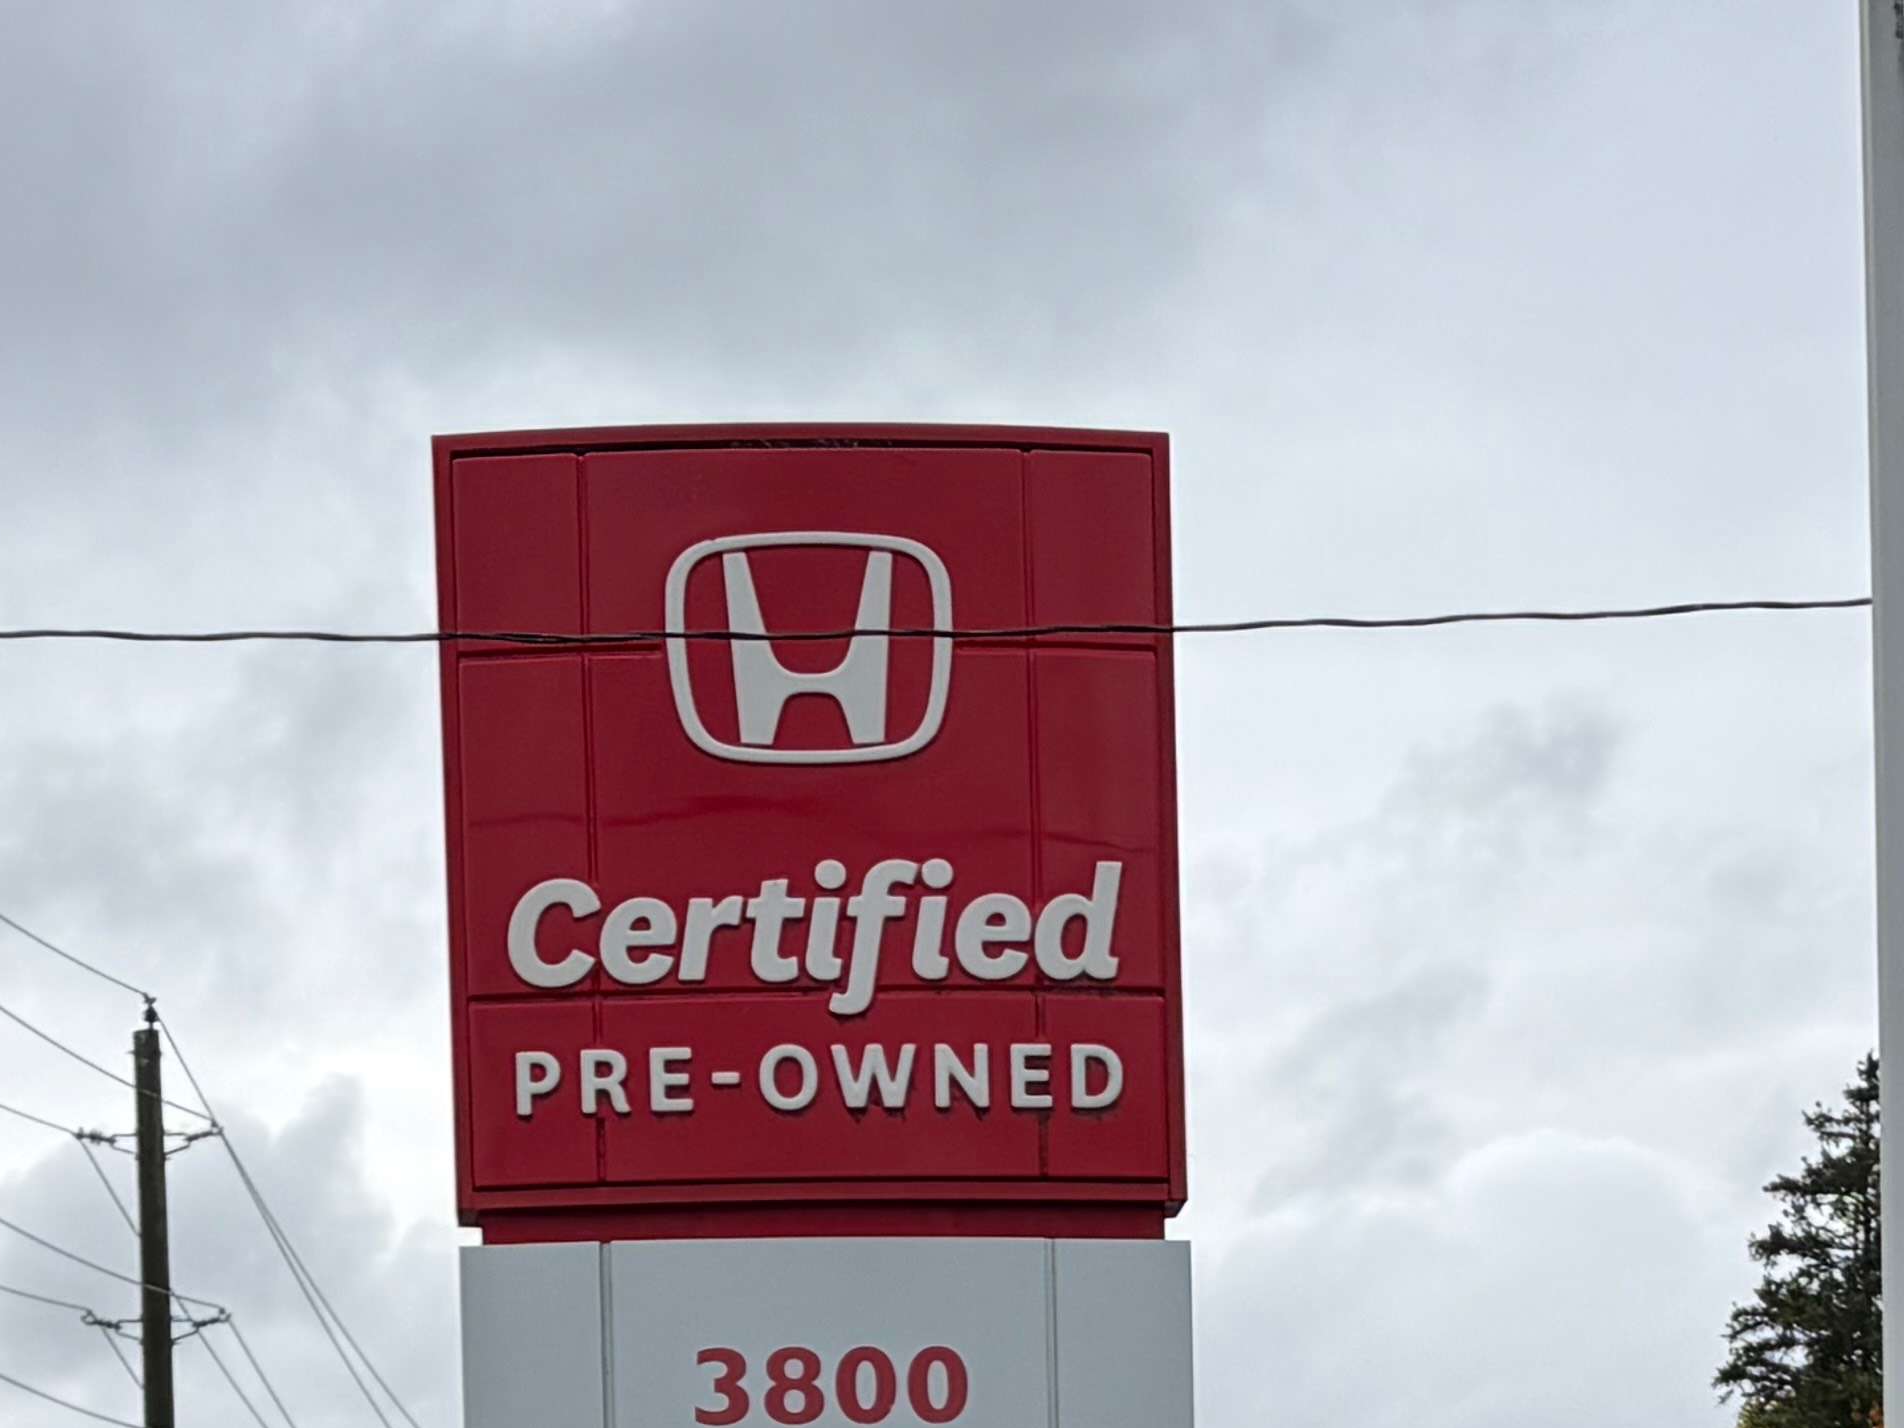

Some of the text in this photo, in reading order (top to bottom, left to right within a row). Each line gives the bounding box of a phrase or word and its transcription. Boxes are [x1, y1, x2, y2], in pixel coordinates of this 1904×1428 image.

[507, 857, 1123, 1015] Certified
[515, 1042, 1125, 1117] PRE-OWNED
[694, 1345, 969, 1426] 3800
